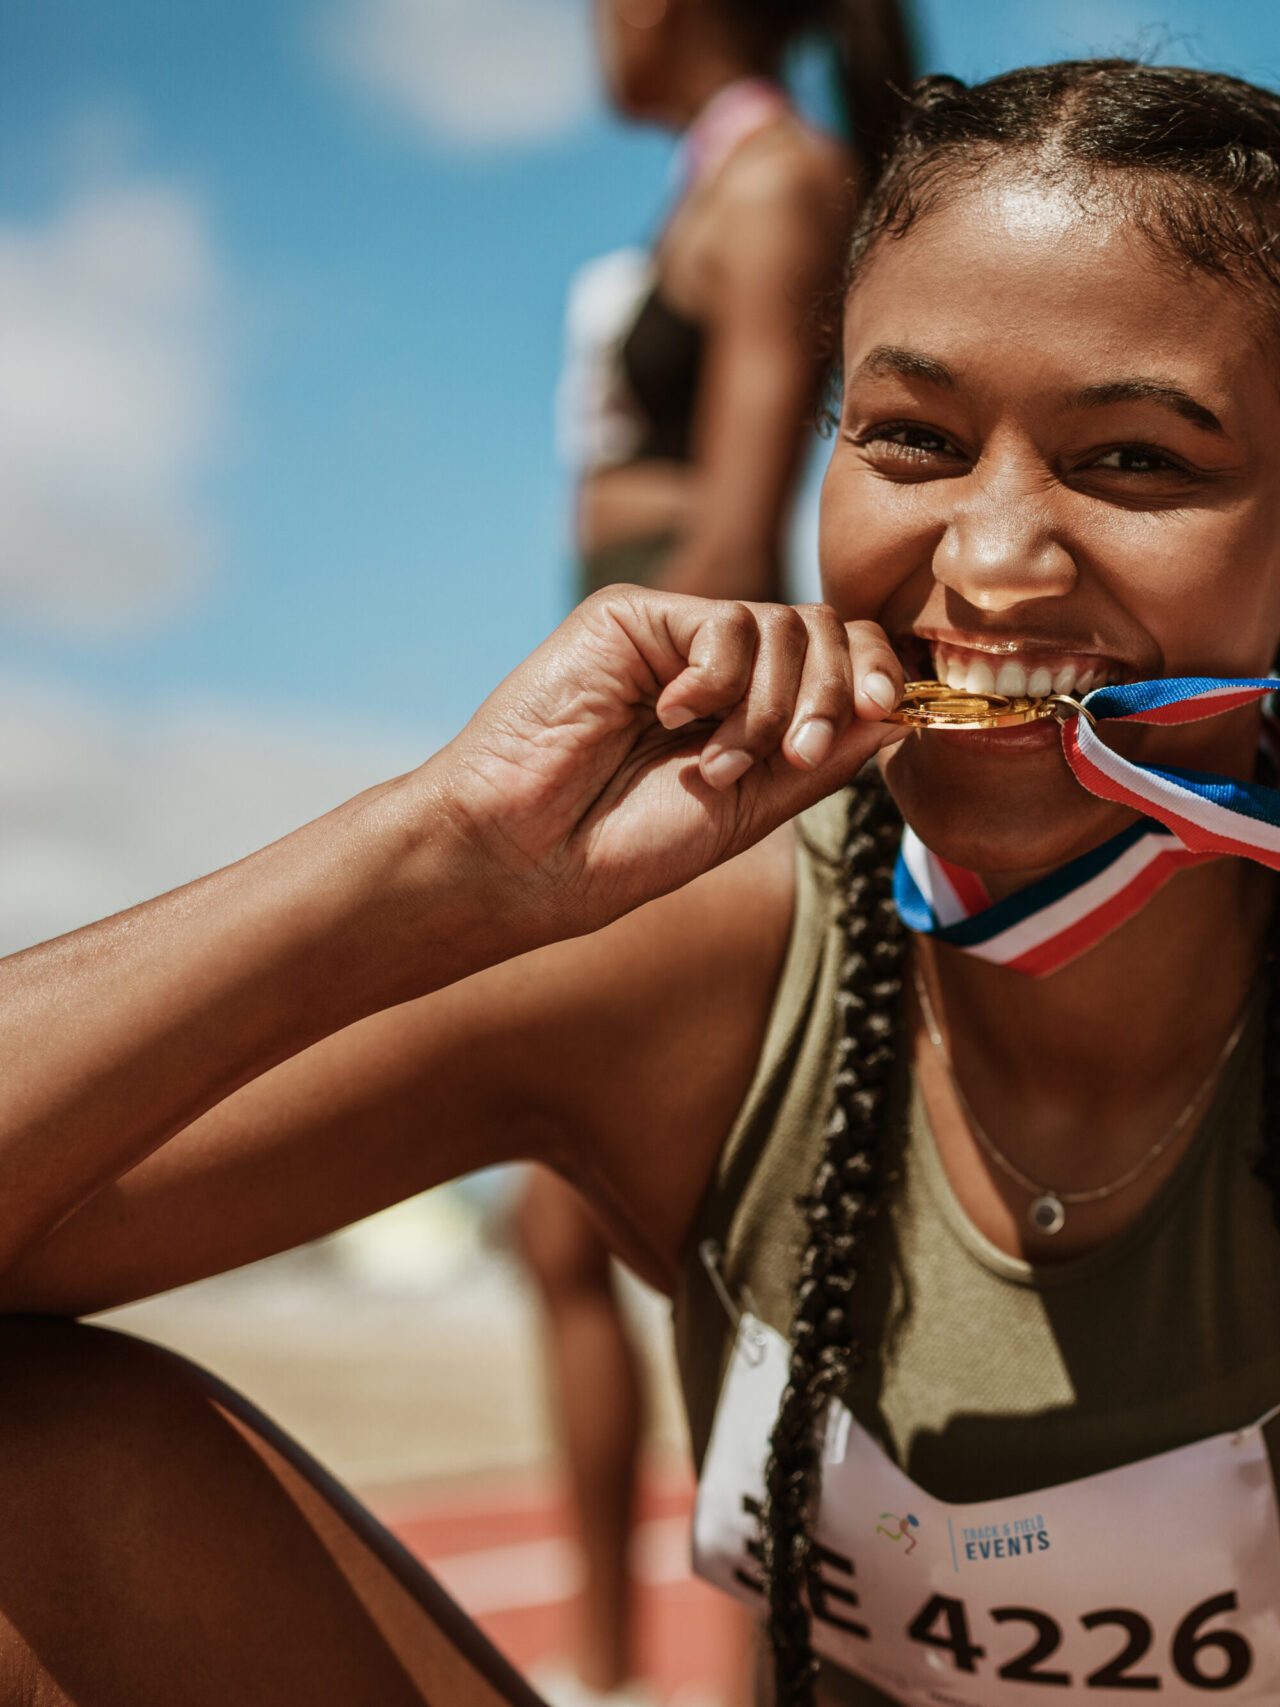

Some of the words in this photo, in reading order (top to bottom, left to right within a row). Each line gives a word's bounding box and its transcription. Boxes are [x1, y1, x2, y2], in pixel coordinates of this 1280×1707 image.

[962, 1524, 998, 1541] TRACK
[1014, 1513, 1044, 1535] FIELD
[966, 1530, 1050, 1560] EVENTS
[906, 1590, 1253, 1692] 4226
